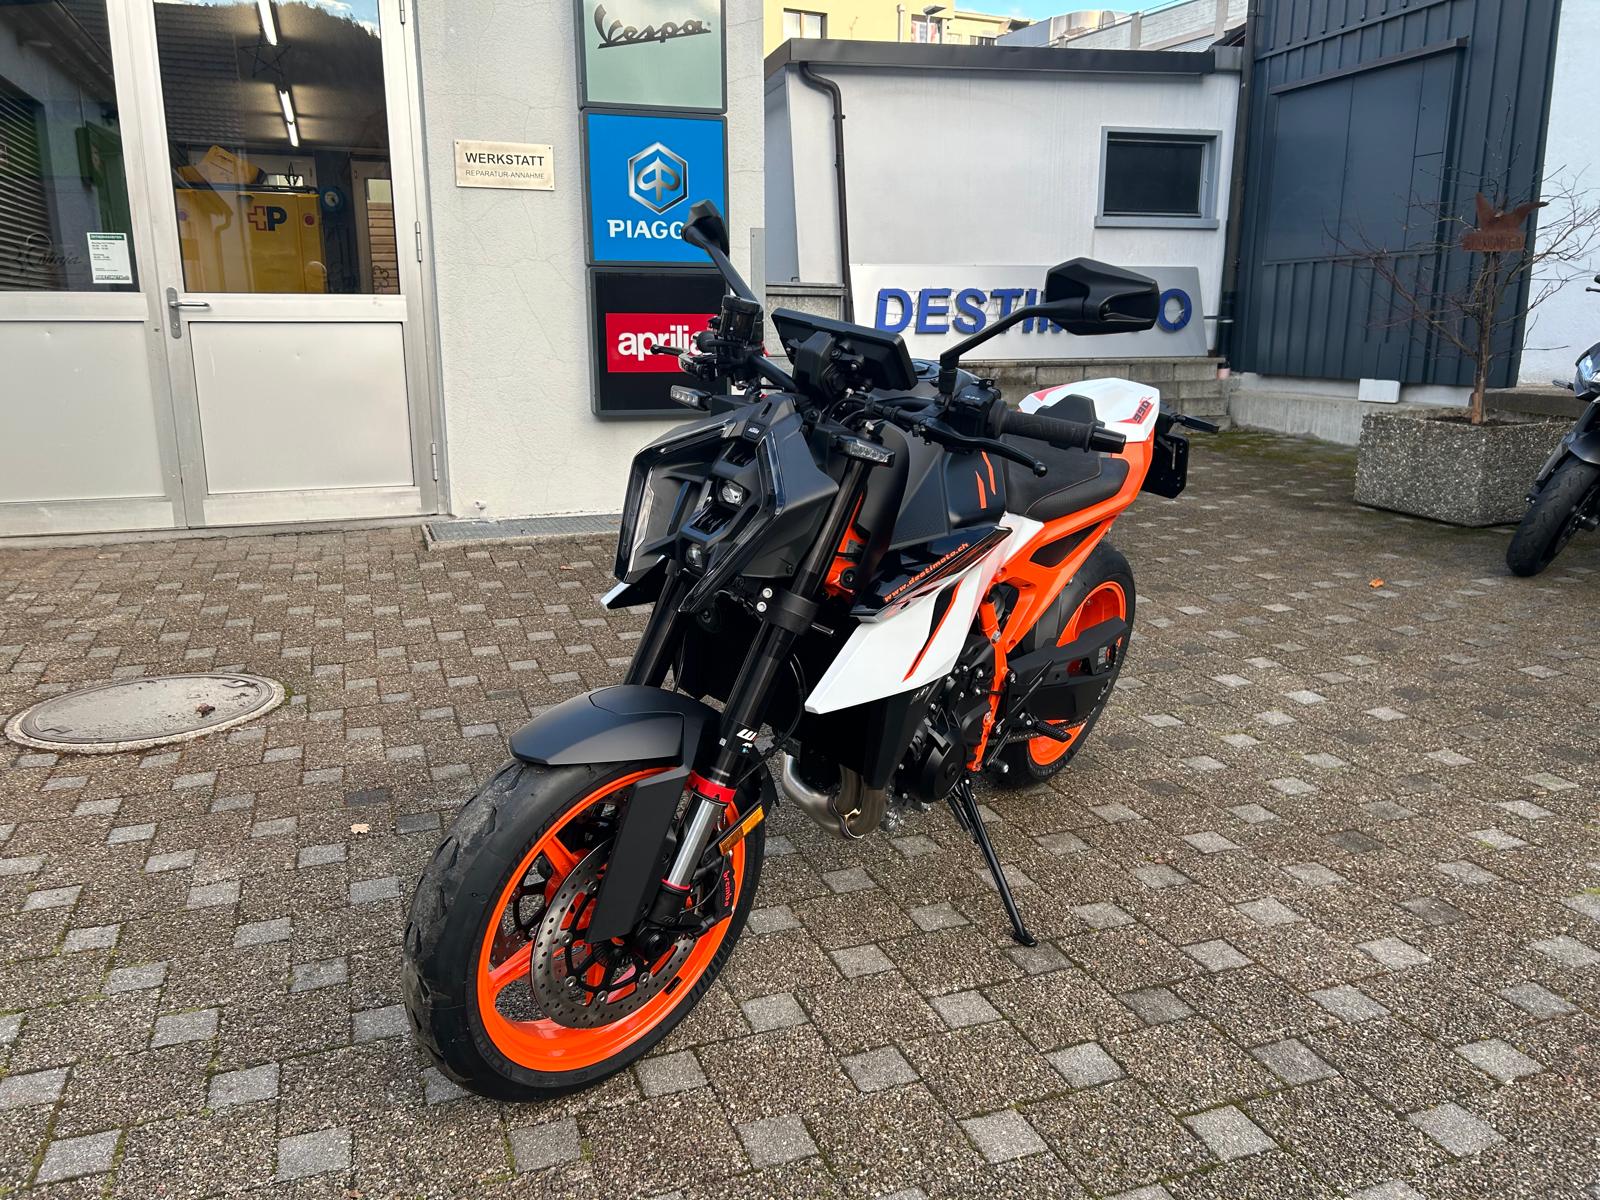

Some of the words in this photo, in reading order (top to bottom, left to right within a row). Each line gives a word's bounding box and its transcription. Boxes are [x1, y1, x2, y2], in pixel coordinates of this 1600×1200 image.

[594, 4, 712, 49] Vespa
[465, 152, 545, 166] WERKSTATT
[465, 169, 545, 180] REPARATUR-ANNAHME
[607, 219, 683, 240] PIAGG
[875, 288, 1193, 335] DESTIO
[884, 542, 969, 603] www.destimoto.ch
